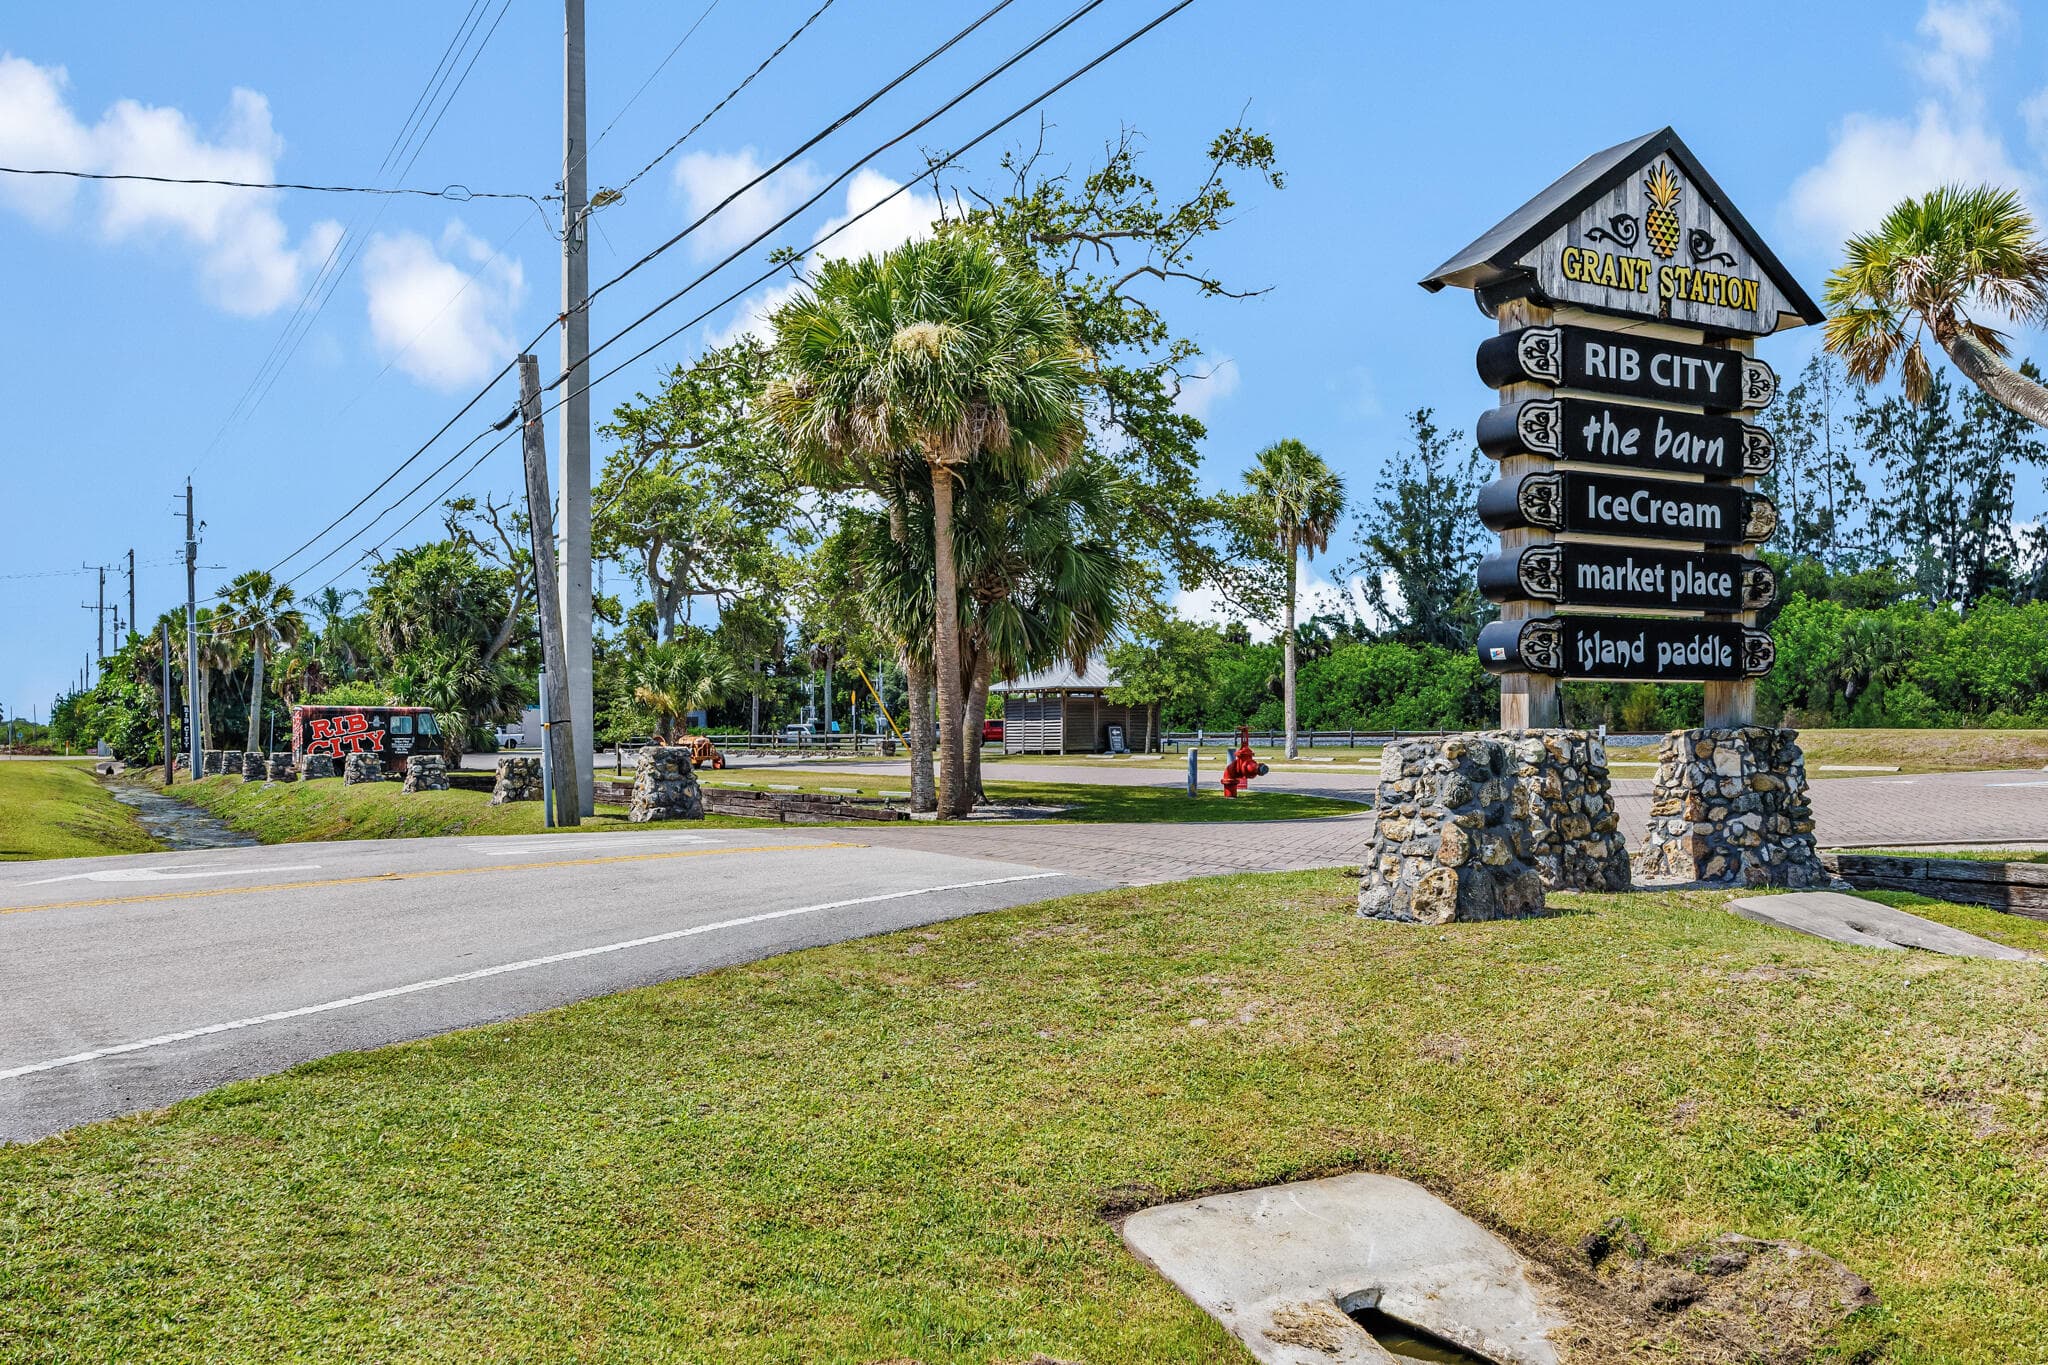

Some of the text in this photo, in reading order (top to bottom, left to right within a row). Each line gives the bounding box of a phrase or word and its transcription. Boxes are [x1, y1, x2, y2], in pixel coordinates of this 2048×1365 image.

[1562, 245, 1759, 311] GRANT STATION
[1585, 342, 1725, 393] RIB CITY
[1583, 410, 1724, 467] the barn
[1588, 485, 1722, 529] IceCream
[1577, 557, 1733, 602] market place
[1576, 630, 1733, 673] island paddle
[307, 730, 385, 759] CITY
[310, 713, 369, 739] RIB
